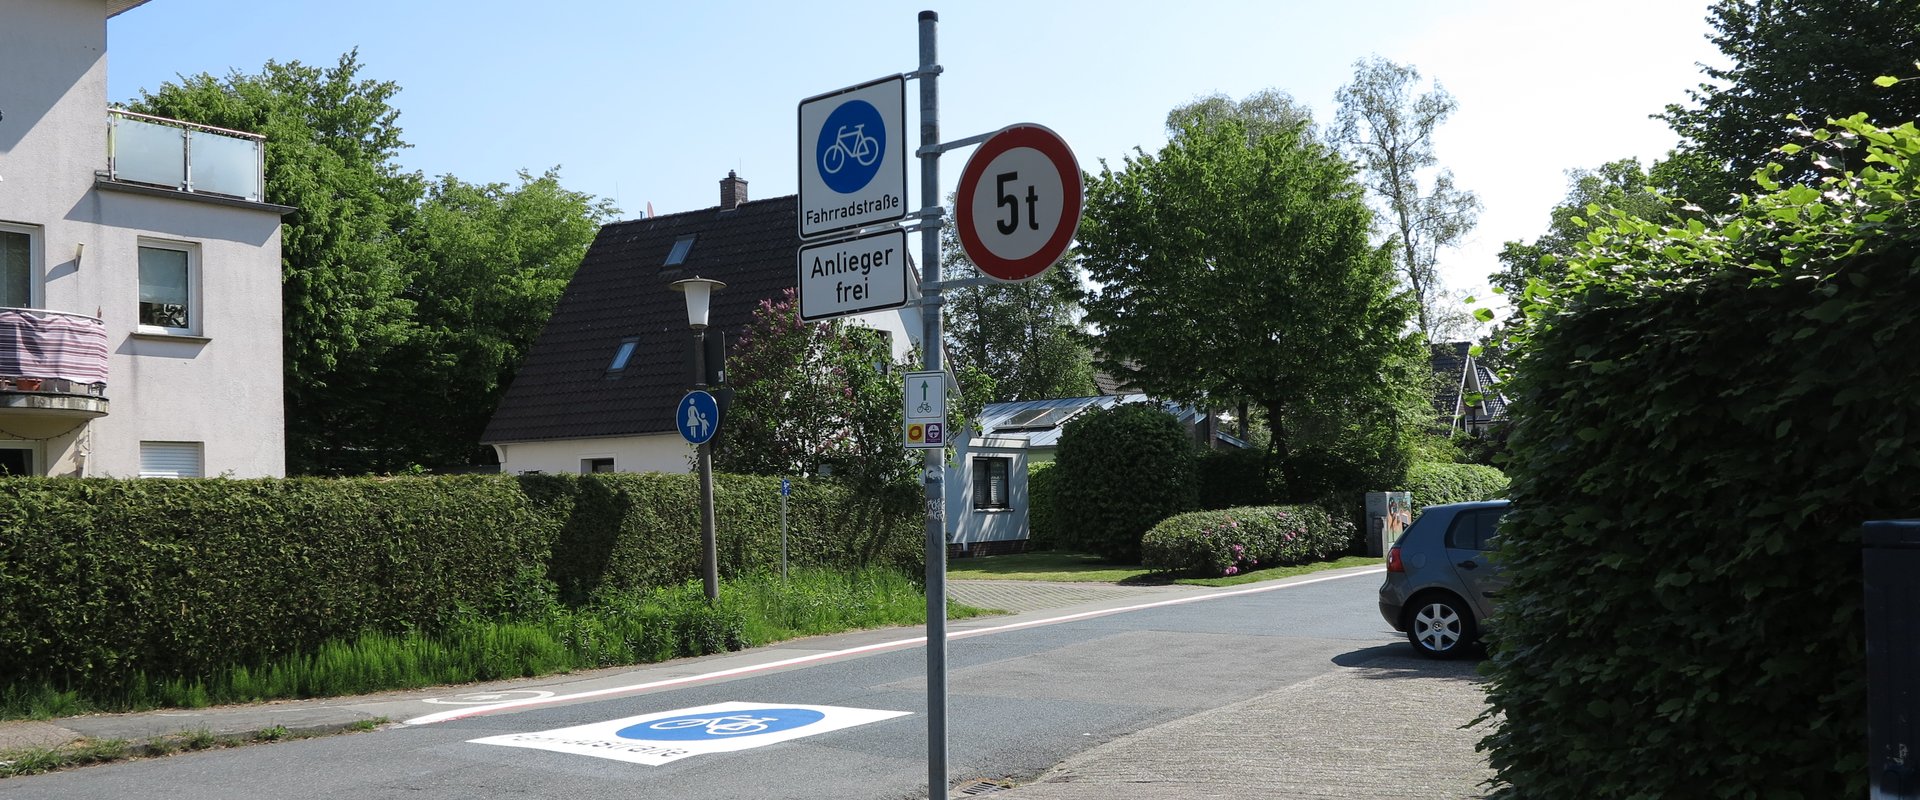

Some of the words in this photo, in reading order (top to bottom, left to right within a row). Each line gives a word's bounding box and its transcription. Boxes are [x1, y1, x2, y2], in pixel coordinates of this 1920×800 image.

[806, 194, 899, 225] Fahrradstraße
[811, 247, 894, 279] Anlieger
[836, 277, 870, 303] frei
